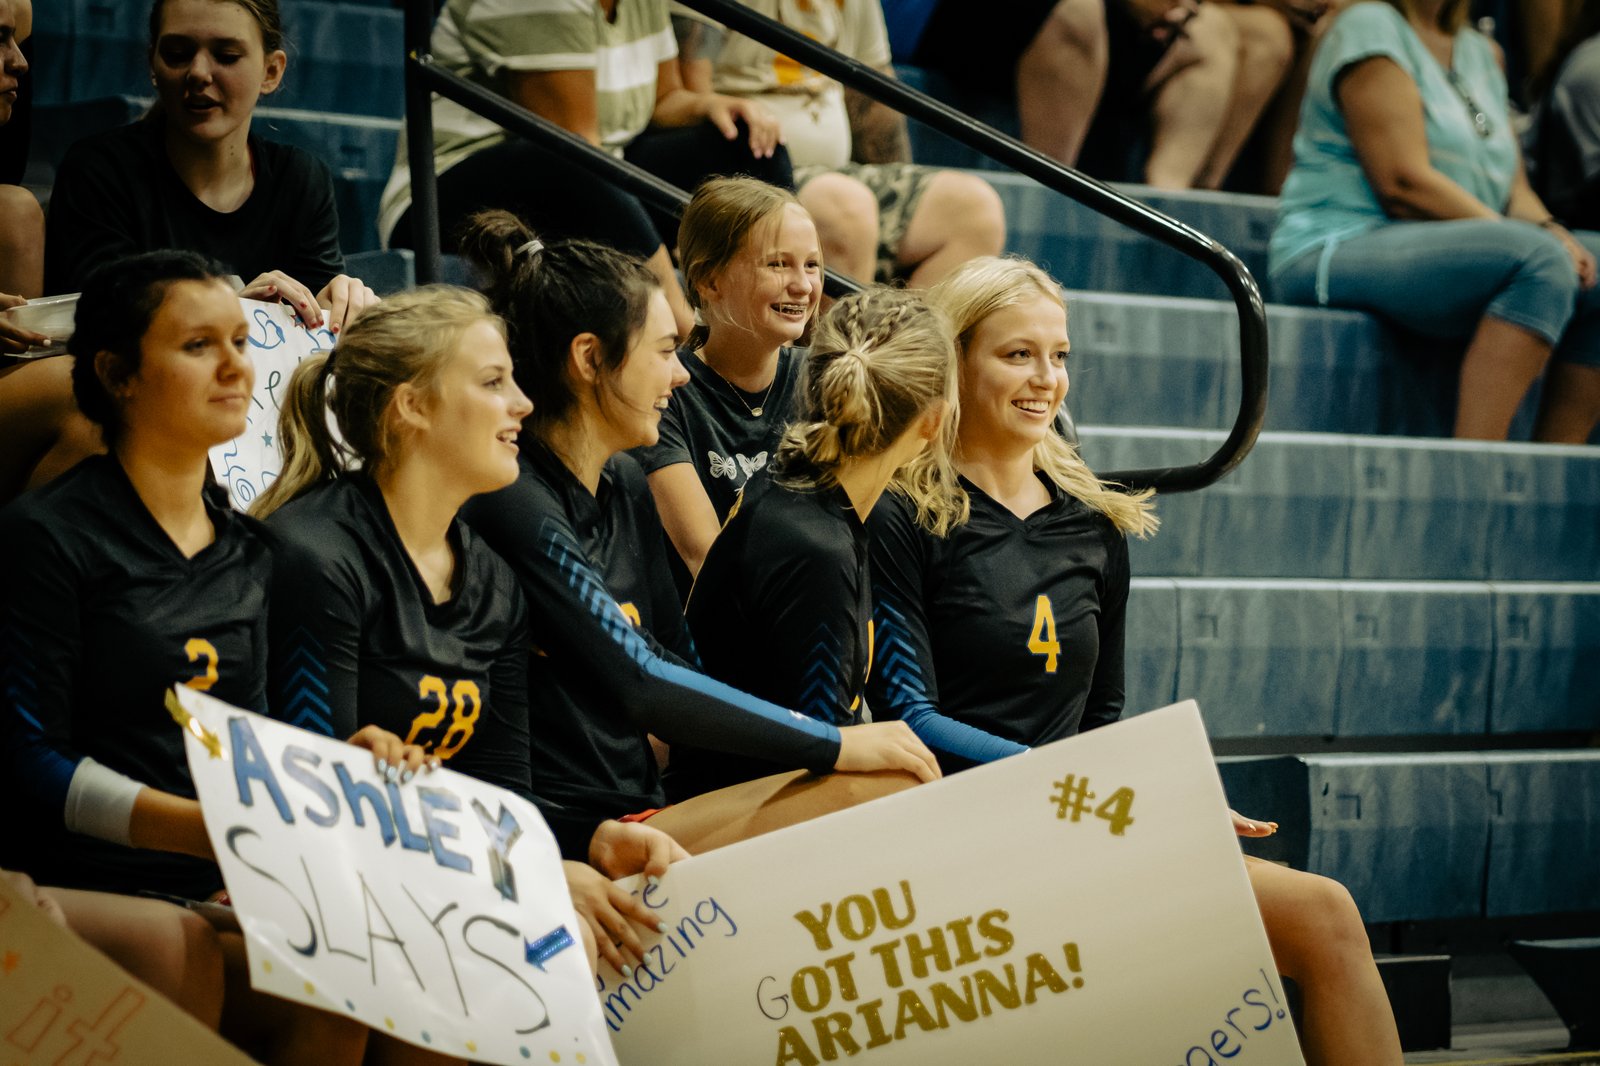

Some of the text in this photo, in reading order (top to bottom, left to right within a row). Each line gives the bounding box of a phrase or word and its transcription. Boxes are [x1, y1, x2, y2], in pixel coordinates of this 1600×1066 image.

[1027, 594, 1061, 673] 4
[404, 674, 482, 760] 28
[1049, 773, 1136, 836] #4
[225, 825, 551, 1035] SLAYS
[793, 879, 917, 951] YOU
[756, 908, 1015, 1021] GOT THIS
[775, 942, 1085, 1066] ARIANNA!
